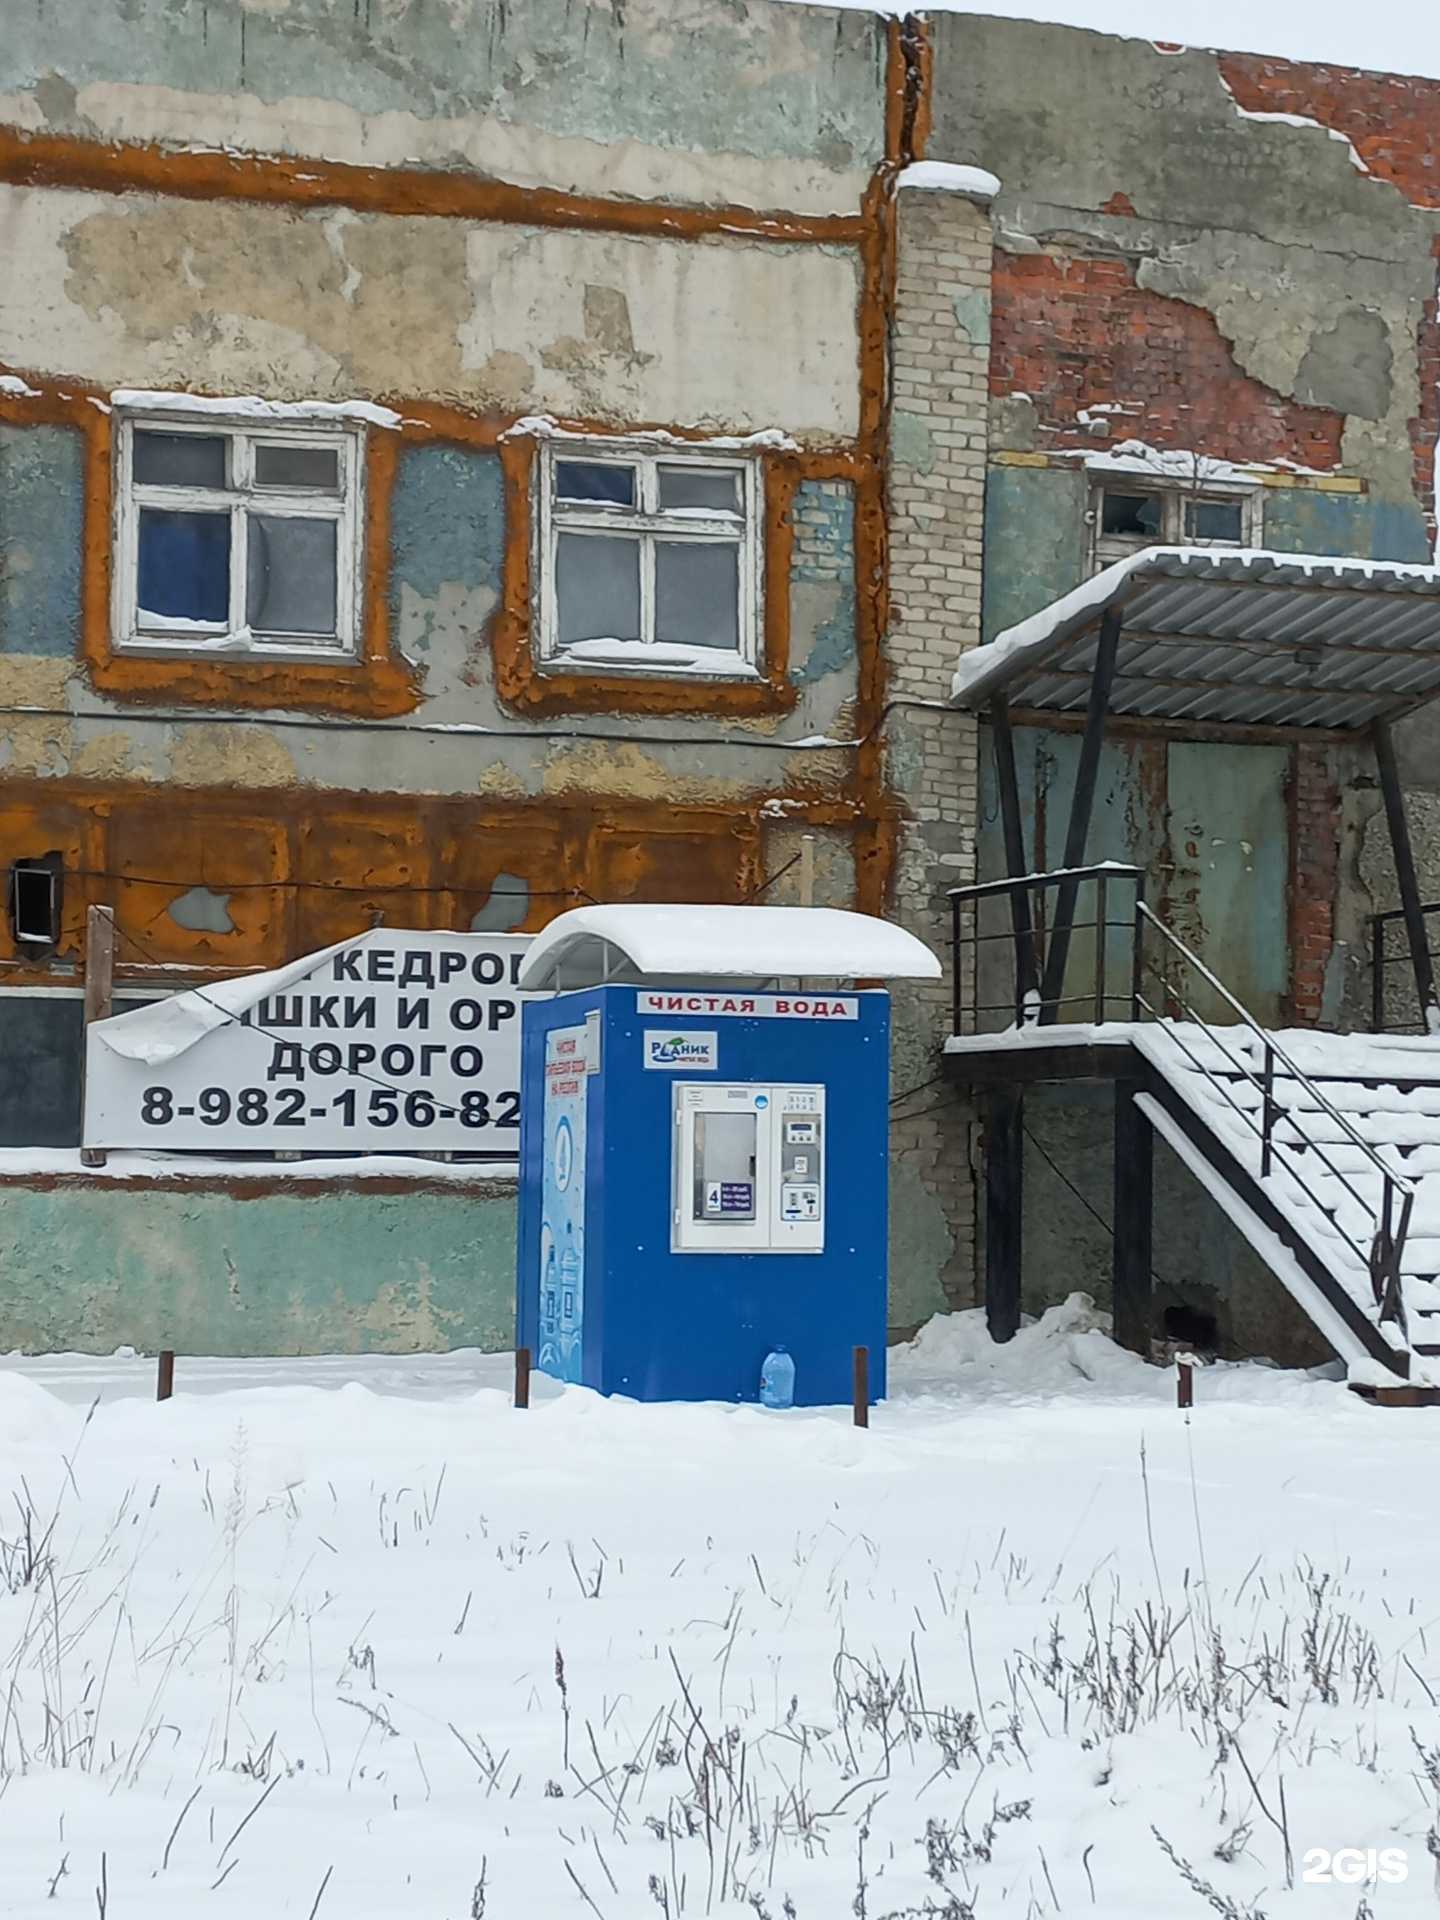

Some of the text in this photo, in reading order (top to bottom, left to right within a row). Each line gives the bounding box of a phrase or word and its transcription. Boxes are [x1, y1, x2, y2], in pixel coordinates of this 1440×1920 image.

[397, 996, 429, 1029] И
[648, 996, 847, 1017] ЧИСТАЯ ВОДА
[266, 1042, 483, 1081] ДОРОГО
[140, 1086, 522, 1128] 8-982-156-82
